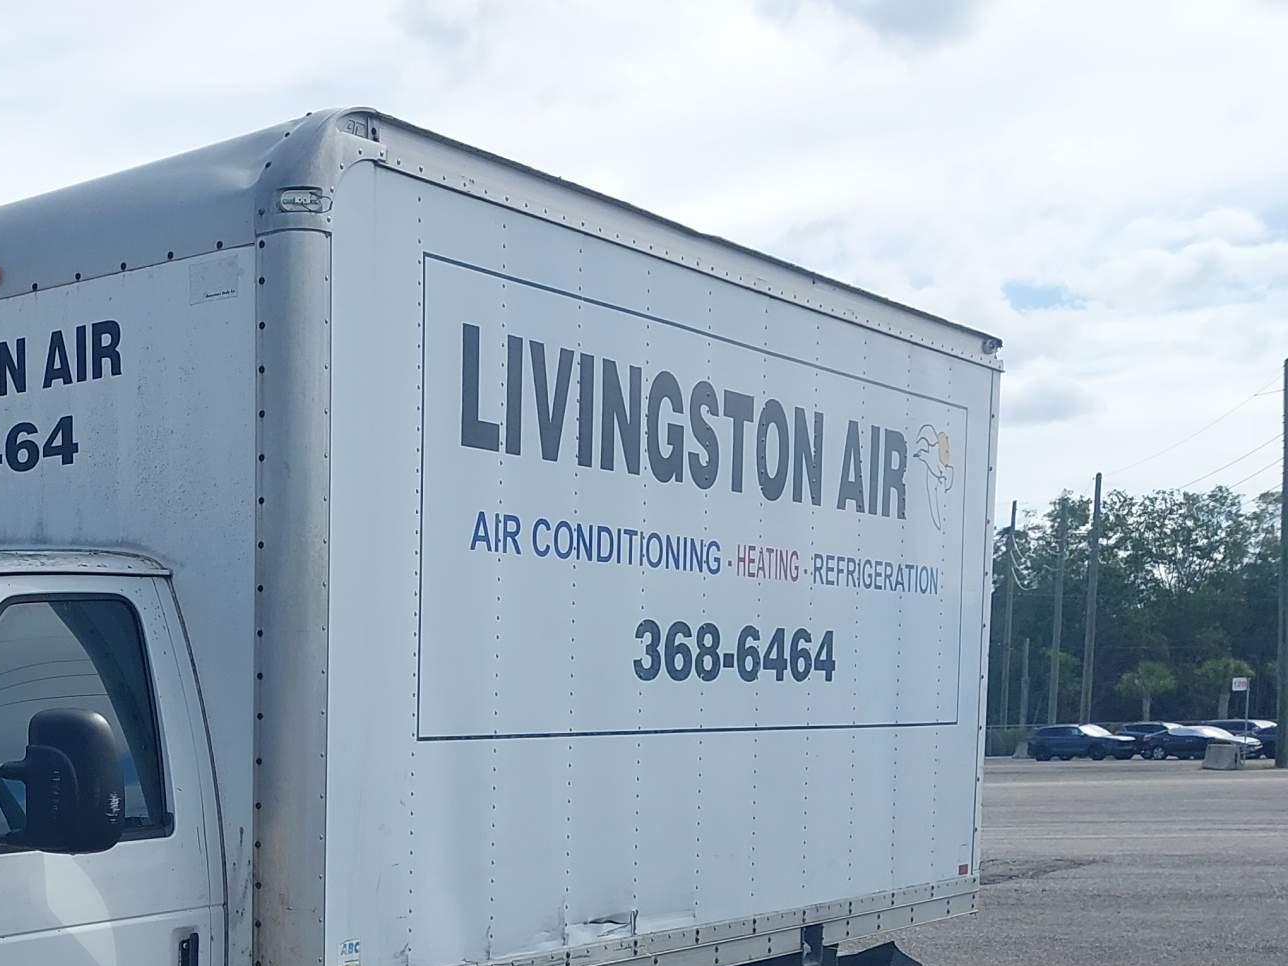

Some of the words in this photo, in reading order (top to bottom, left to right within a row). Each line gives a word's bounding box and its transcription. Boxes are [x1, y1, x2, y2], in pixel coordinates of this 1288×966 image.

[43, 319, 123, 388] AIR
[460, 322, 824, 506] LIVINGSTON
[838, 420, 908, 520] AIR
[470, 511, 522, 555] AIR
[531, 517, 722, 576] CONDITIONING
[736, 544, 800, 583] HEATING
[812, 553, 940, 595] REFRIGERATION
[633, 618, 836, 682] 368-6464
[340, 941, 360, 956] ABC
